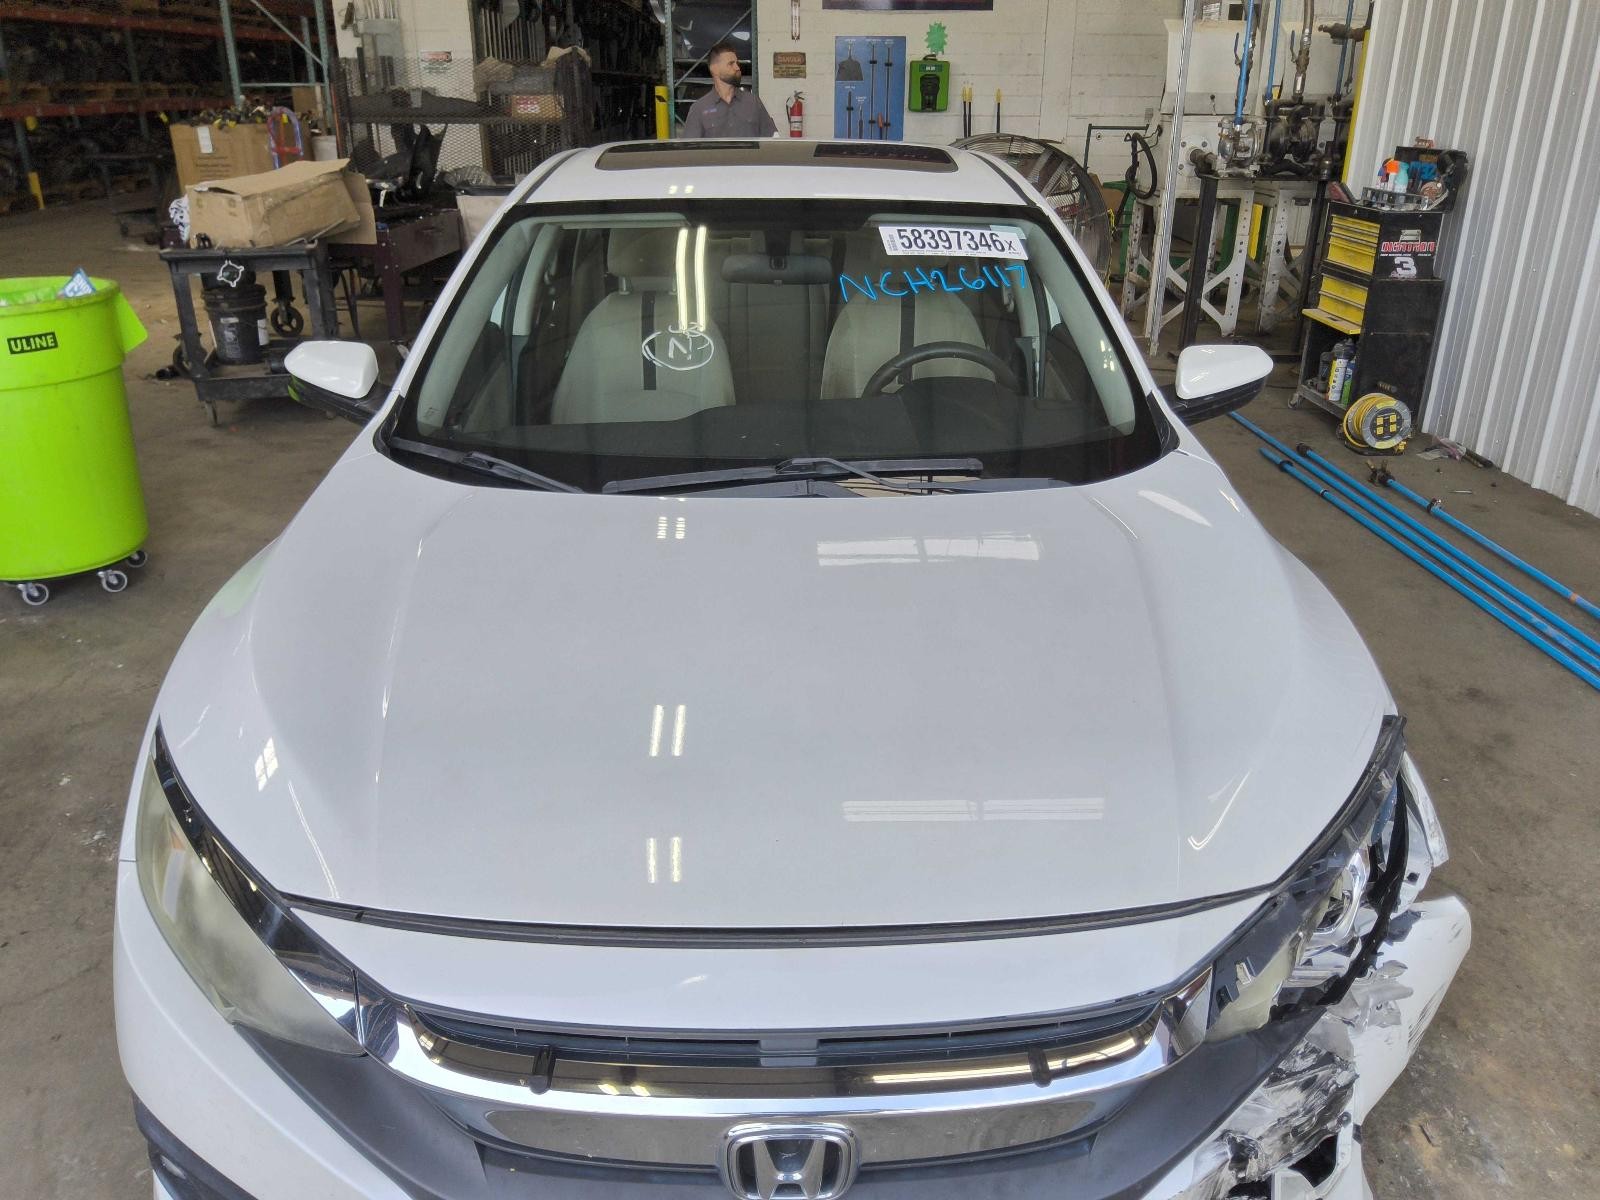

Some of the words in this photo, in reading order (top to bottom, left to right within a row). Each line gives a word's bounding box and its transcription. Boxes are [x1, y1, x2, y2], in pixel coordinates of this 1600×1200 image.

[896, 228, 1005, 253] 58397346
[1394, 256, 1417, 278] 3
[839, 264, 1026, 303] NCH26117
[10, 334, 56, 352] ULINE
